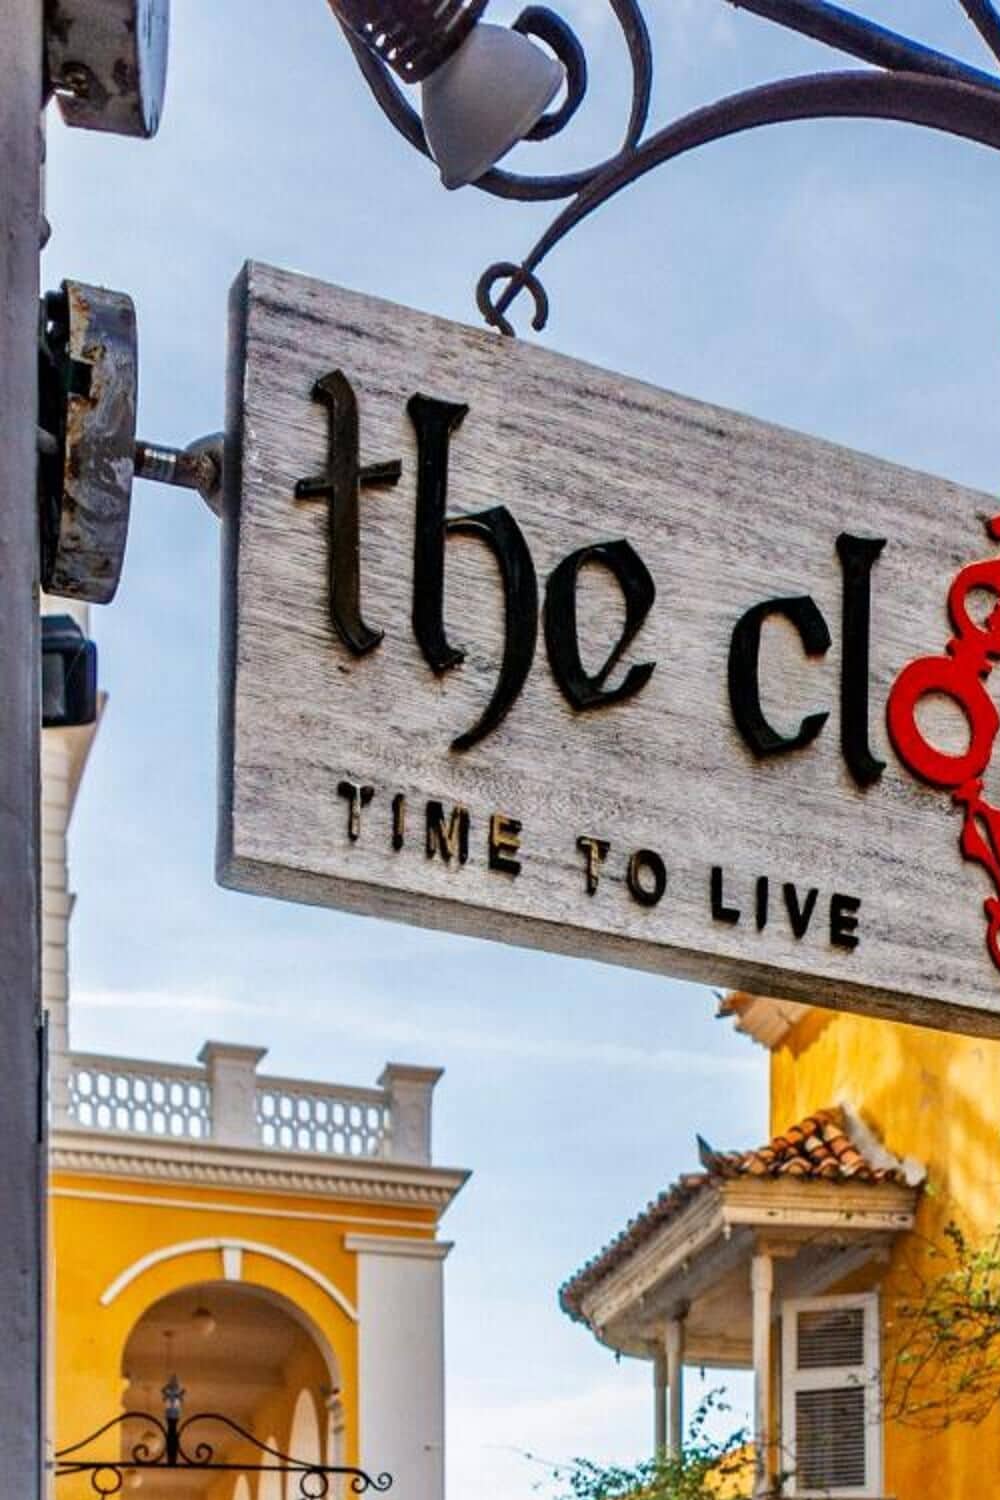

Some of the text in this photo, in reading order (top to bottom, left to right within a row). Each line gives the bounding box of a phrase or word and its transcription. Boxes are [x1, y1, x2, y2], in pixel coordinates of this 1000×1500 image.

[294, 368, 657, 752] the
[337, 780, 862, 949] TIME TO LIVE
